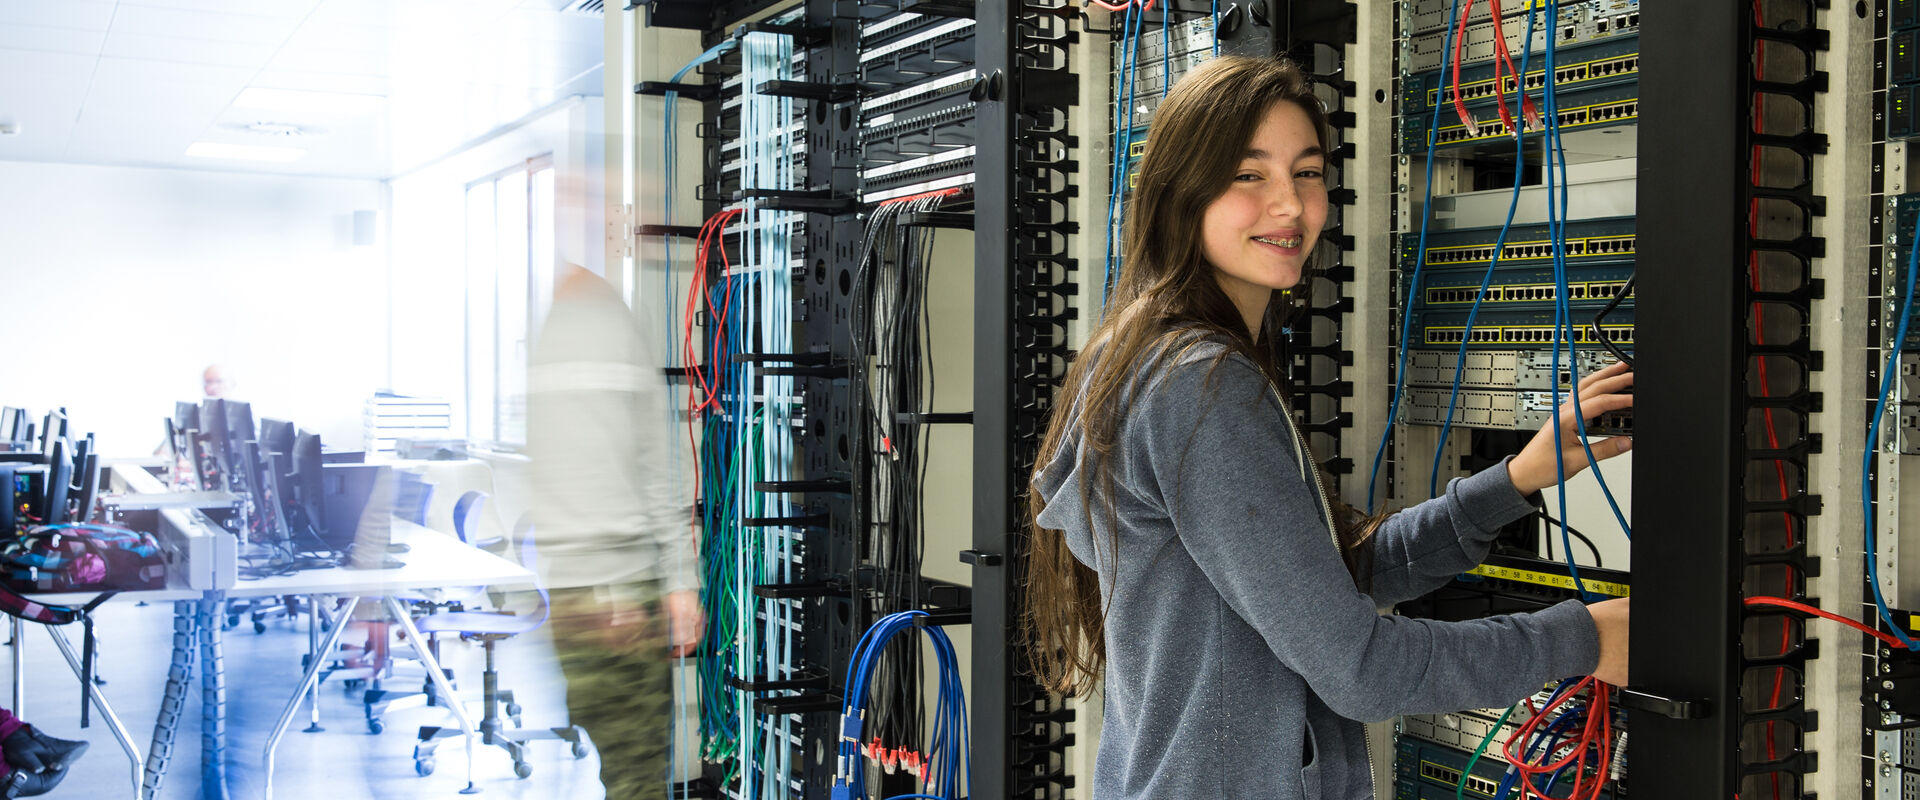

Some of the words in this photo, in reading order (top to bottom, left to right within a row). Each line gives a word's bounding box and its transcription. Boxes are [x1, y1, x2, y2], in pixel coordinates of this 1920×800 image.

[1877, 9, 1884, 17] 10
[1876, 61, 1883, 69] 11
[1875, 112, 1881, 121] 12
[1874, 164, 1880, 172] 13
[1870, 319, 1877, 327] 16
[1869, 370, 1876, 378] 17
[1865, 727, 1872, 736] 24
[1865, 778, 1872, 788] 25
